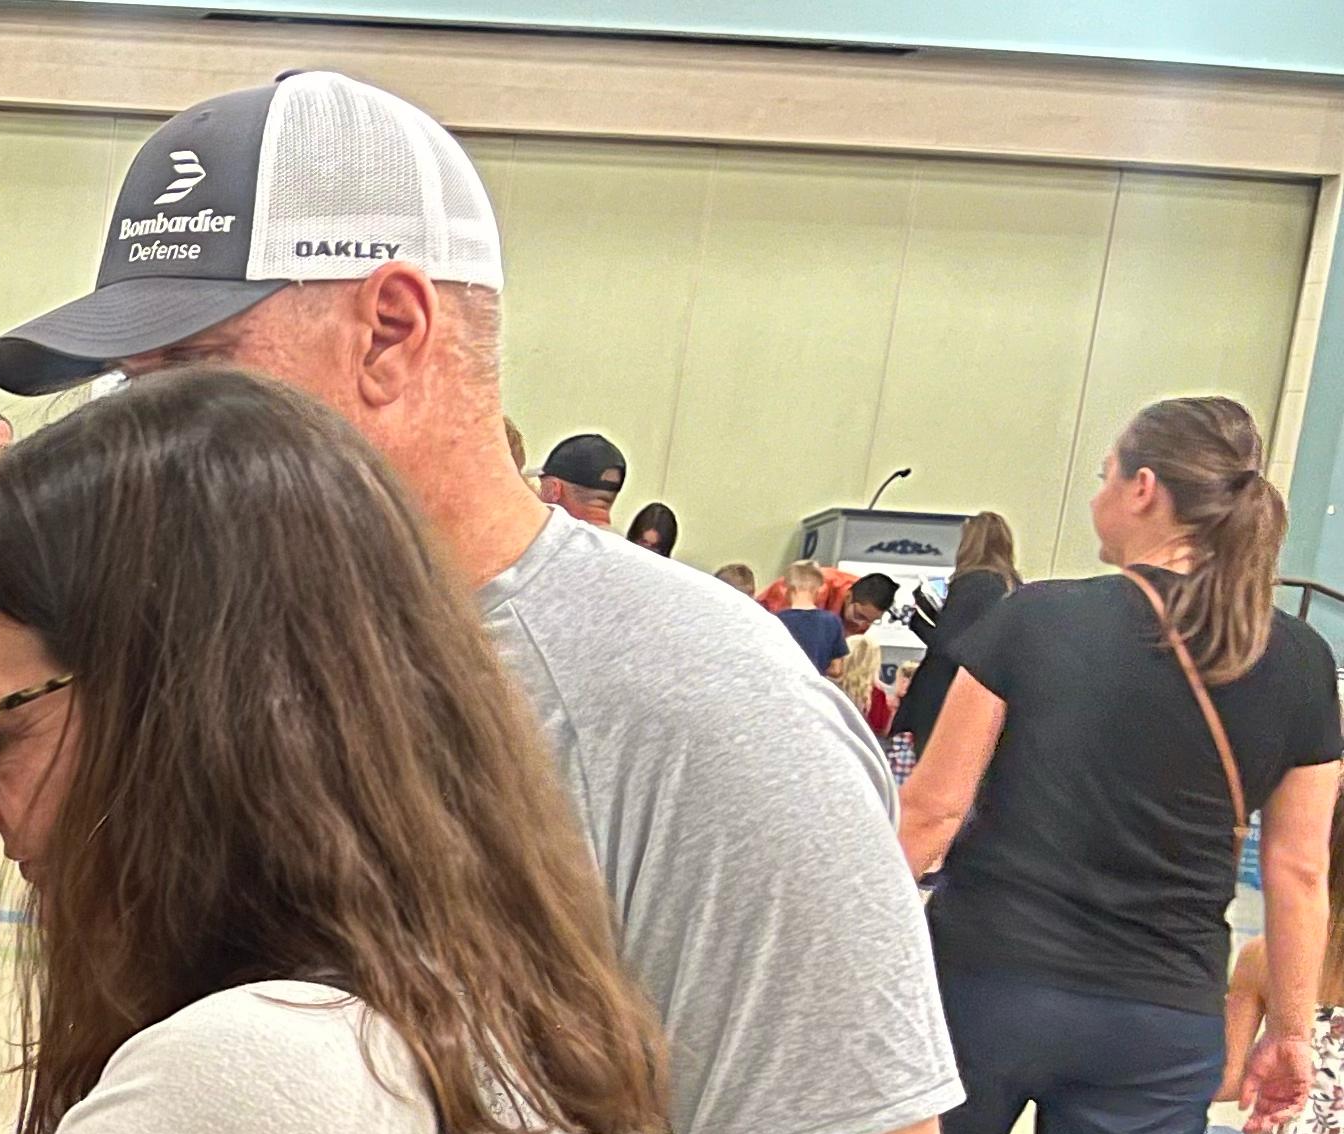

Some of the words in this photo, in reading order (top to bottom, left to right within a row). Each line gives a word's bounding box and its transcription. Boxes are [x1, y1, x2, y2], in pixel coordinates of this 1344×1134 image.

[118, 208, 236, 240] Bombardier
[128, 240, 201, 262] Defense
[295, 240, 401, 260] OAKLEY
